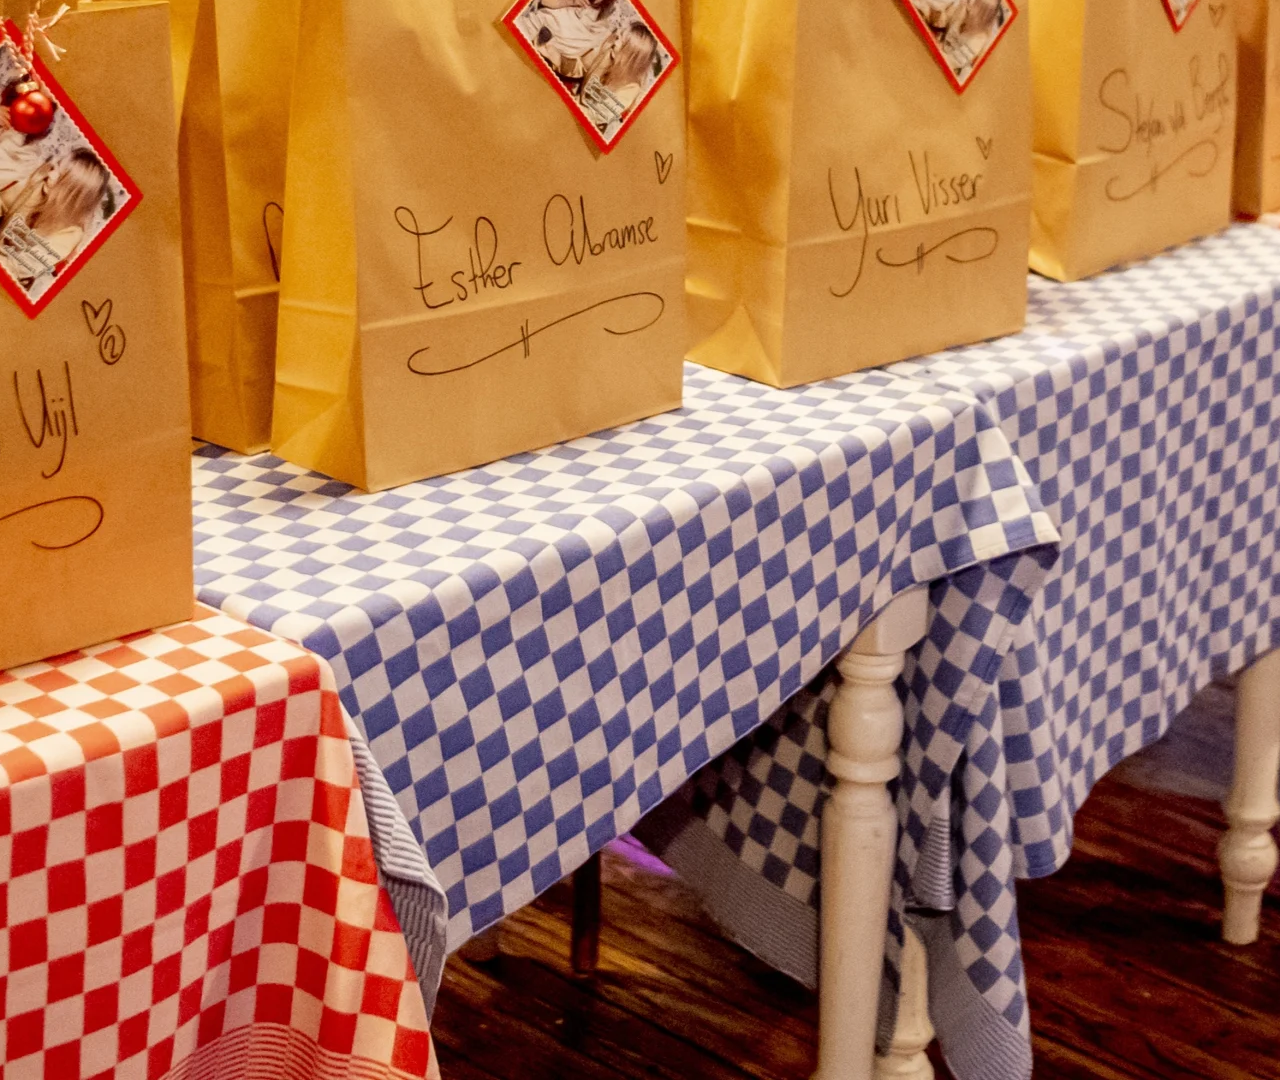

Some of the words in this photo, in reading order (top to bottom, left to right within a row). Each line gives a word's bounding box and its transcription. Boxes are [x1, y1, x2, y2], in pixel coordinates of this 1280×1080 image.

[394, 206, 522, 310] Esther
[828, 166, 901, 297] Yuri
[908, 150, 983, 215] Visser
